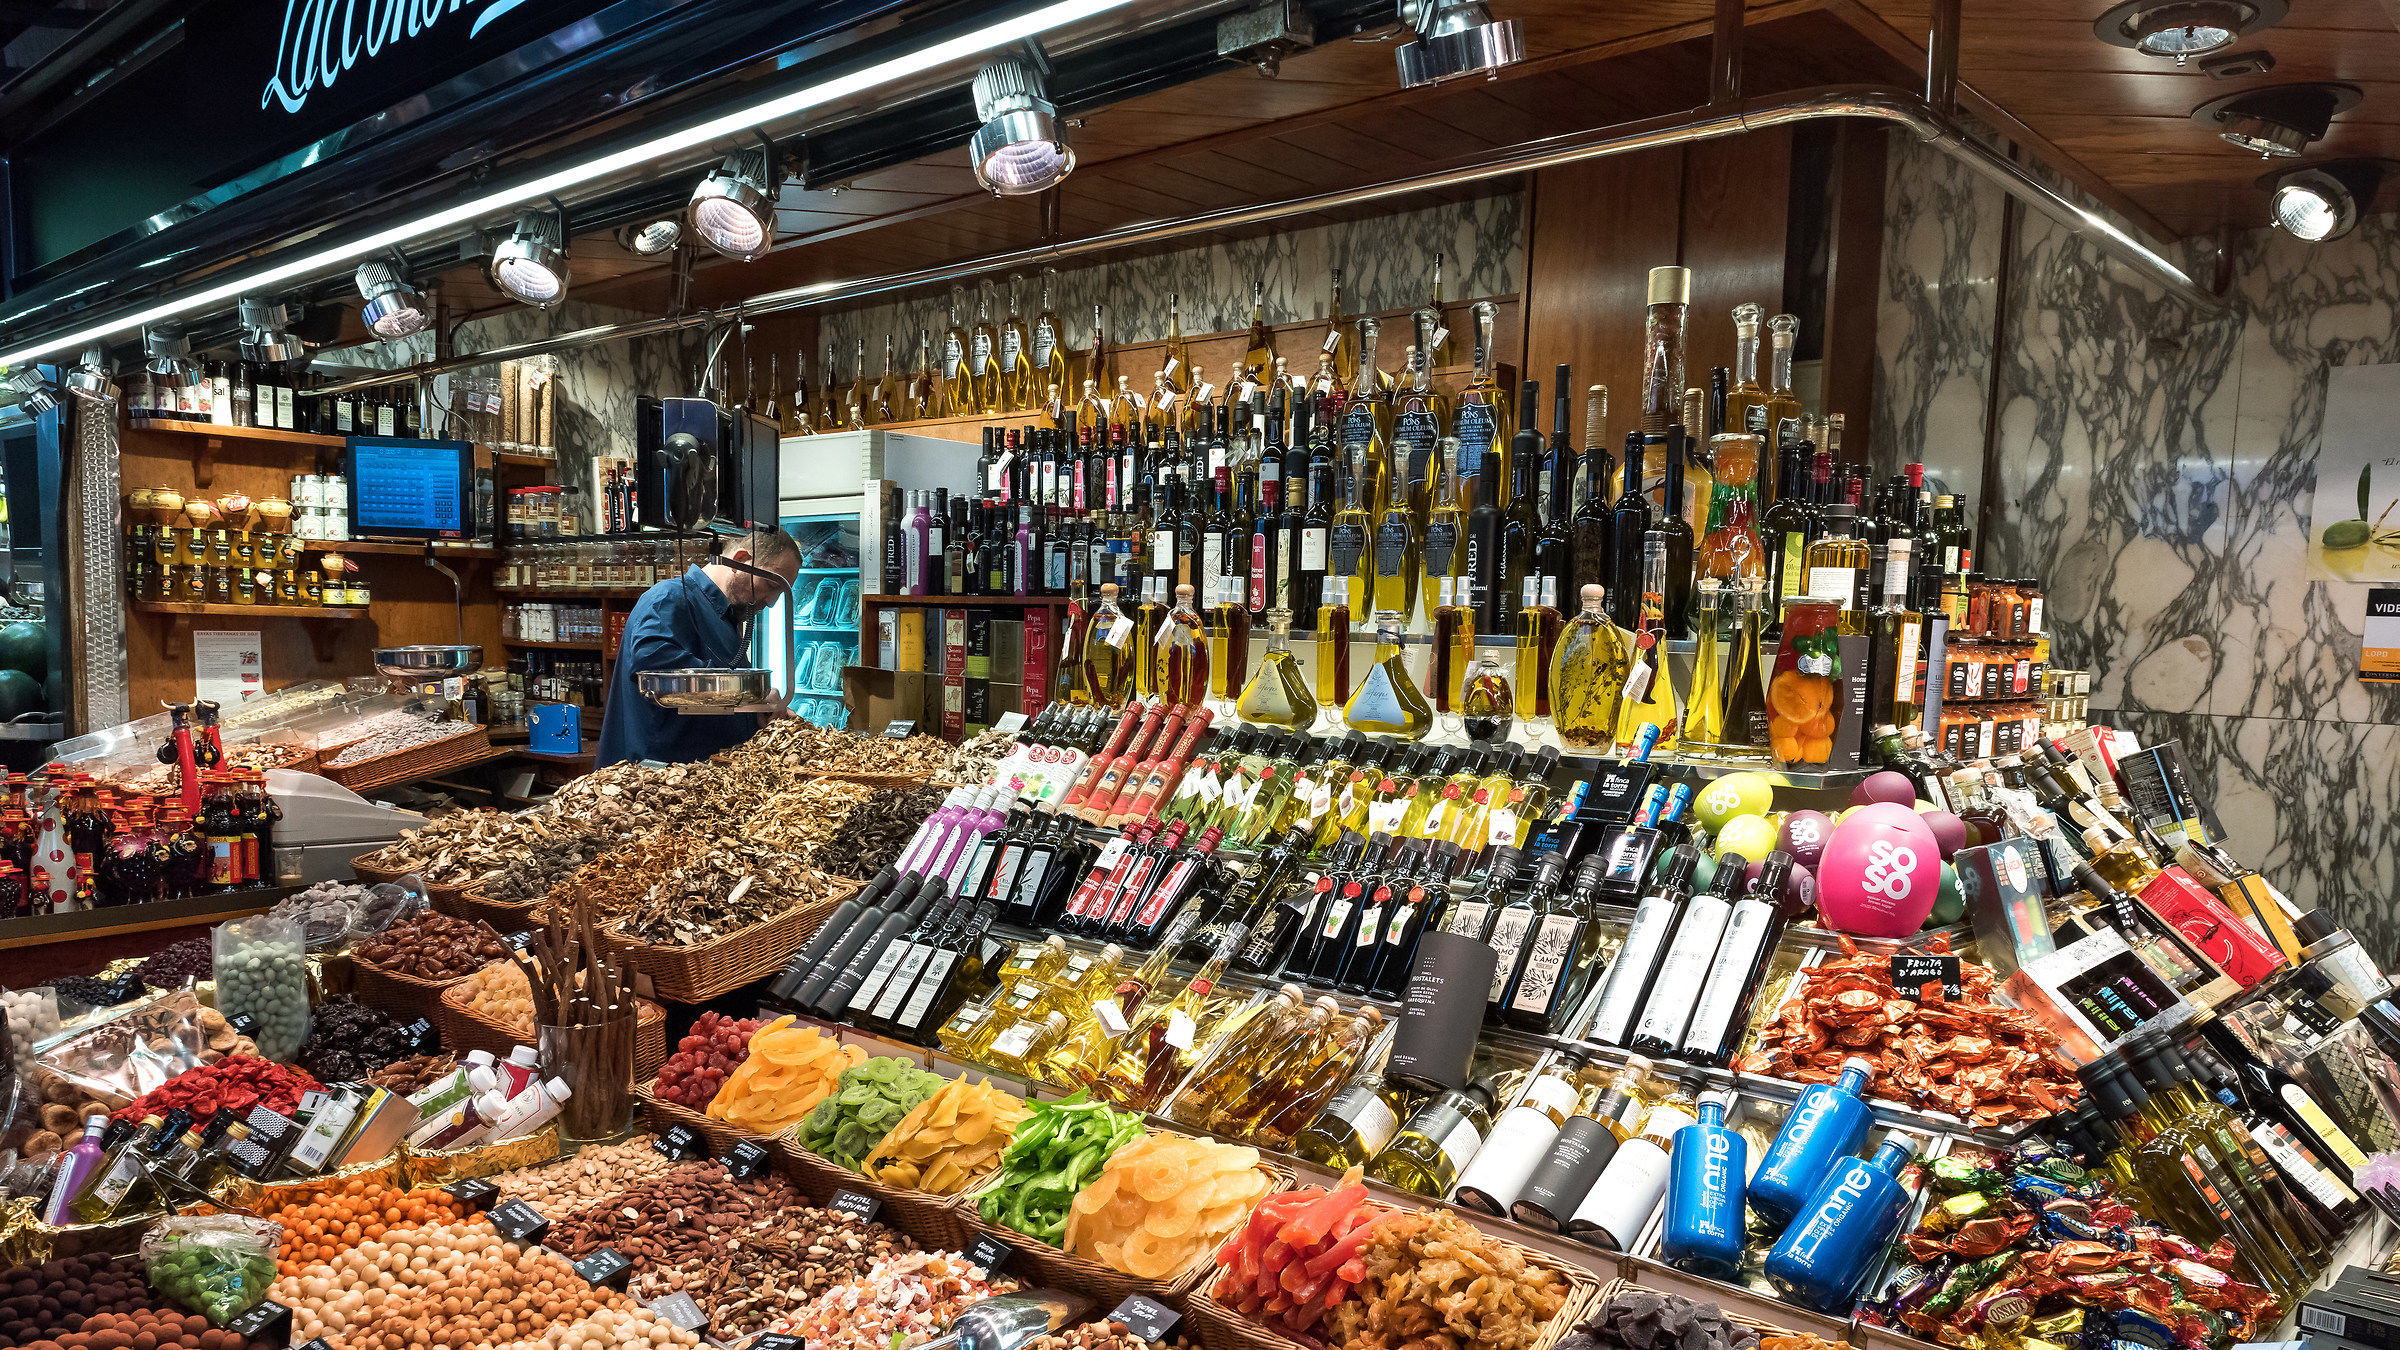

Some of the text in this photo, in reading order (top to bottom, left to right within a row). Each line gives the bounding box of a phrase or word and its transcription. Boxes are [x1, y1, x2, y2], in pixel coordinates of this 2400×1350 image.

[213, 387, 225, 396] sal
[1402, 416, 1420, 427] PONS
[1196, 460, 1204, 481] RED
[887, 538, 896, 565] FRED
[1468, 540, 1478, 580] FRED
[1027, 614, 1041, 623] Pepa
[2365, 650, 2388, 658] LOPD
[1026, 686, 1039, 695] Pepa
[1614, 776, 1630, 784] finca
[1869, 840, 1917, 875] SO
[1861, 863, 1912, 900] SO
[853, 934, 881, 967] FRED
[1496, 947, 1515, 957] AMO
[1534, 954, 1560, 965] L'AMO
[1907, 959, 1942, 968] FRUITA
[1412, 975, 1445, 984] HOSTALETS
[1561, 1138, 1591, 1154] HOSTALETS
[1702, 1133, 1730, 1192] one
[1720, 1165, 1728, 1193] ORGANIC
[1820, 1167, 1872, 1217] one
[832, 1199, 868, 1213] NATURAL
[1833, 1201, 1854, 1234] ORGANIC
[1990, 1296, 2026, 1321] JAYSSO
